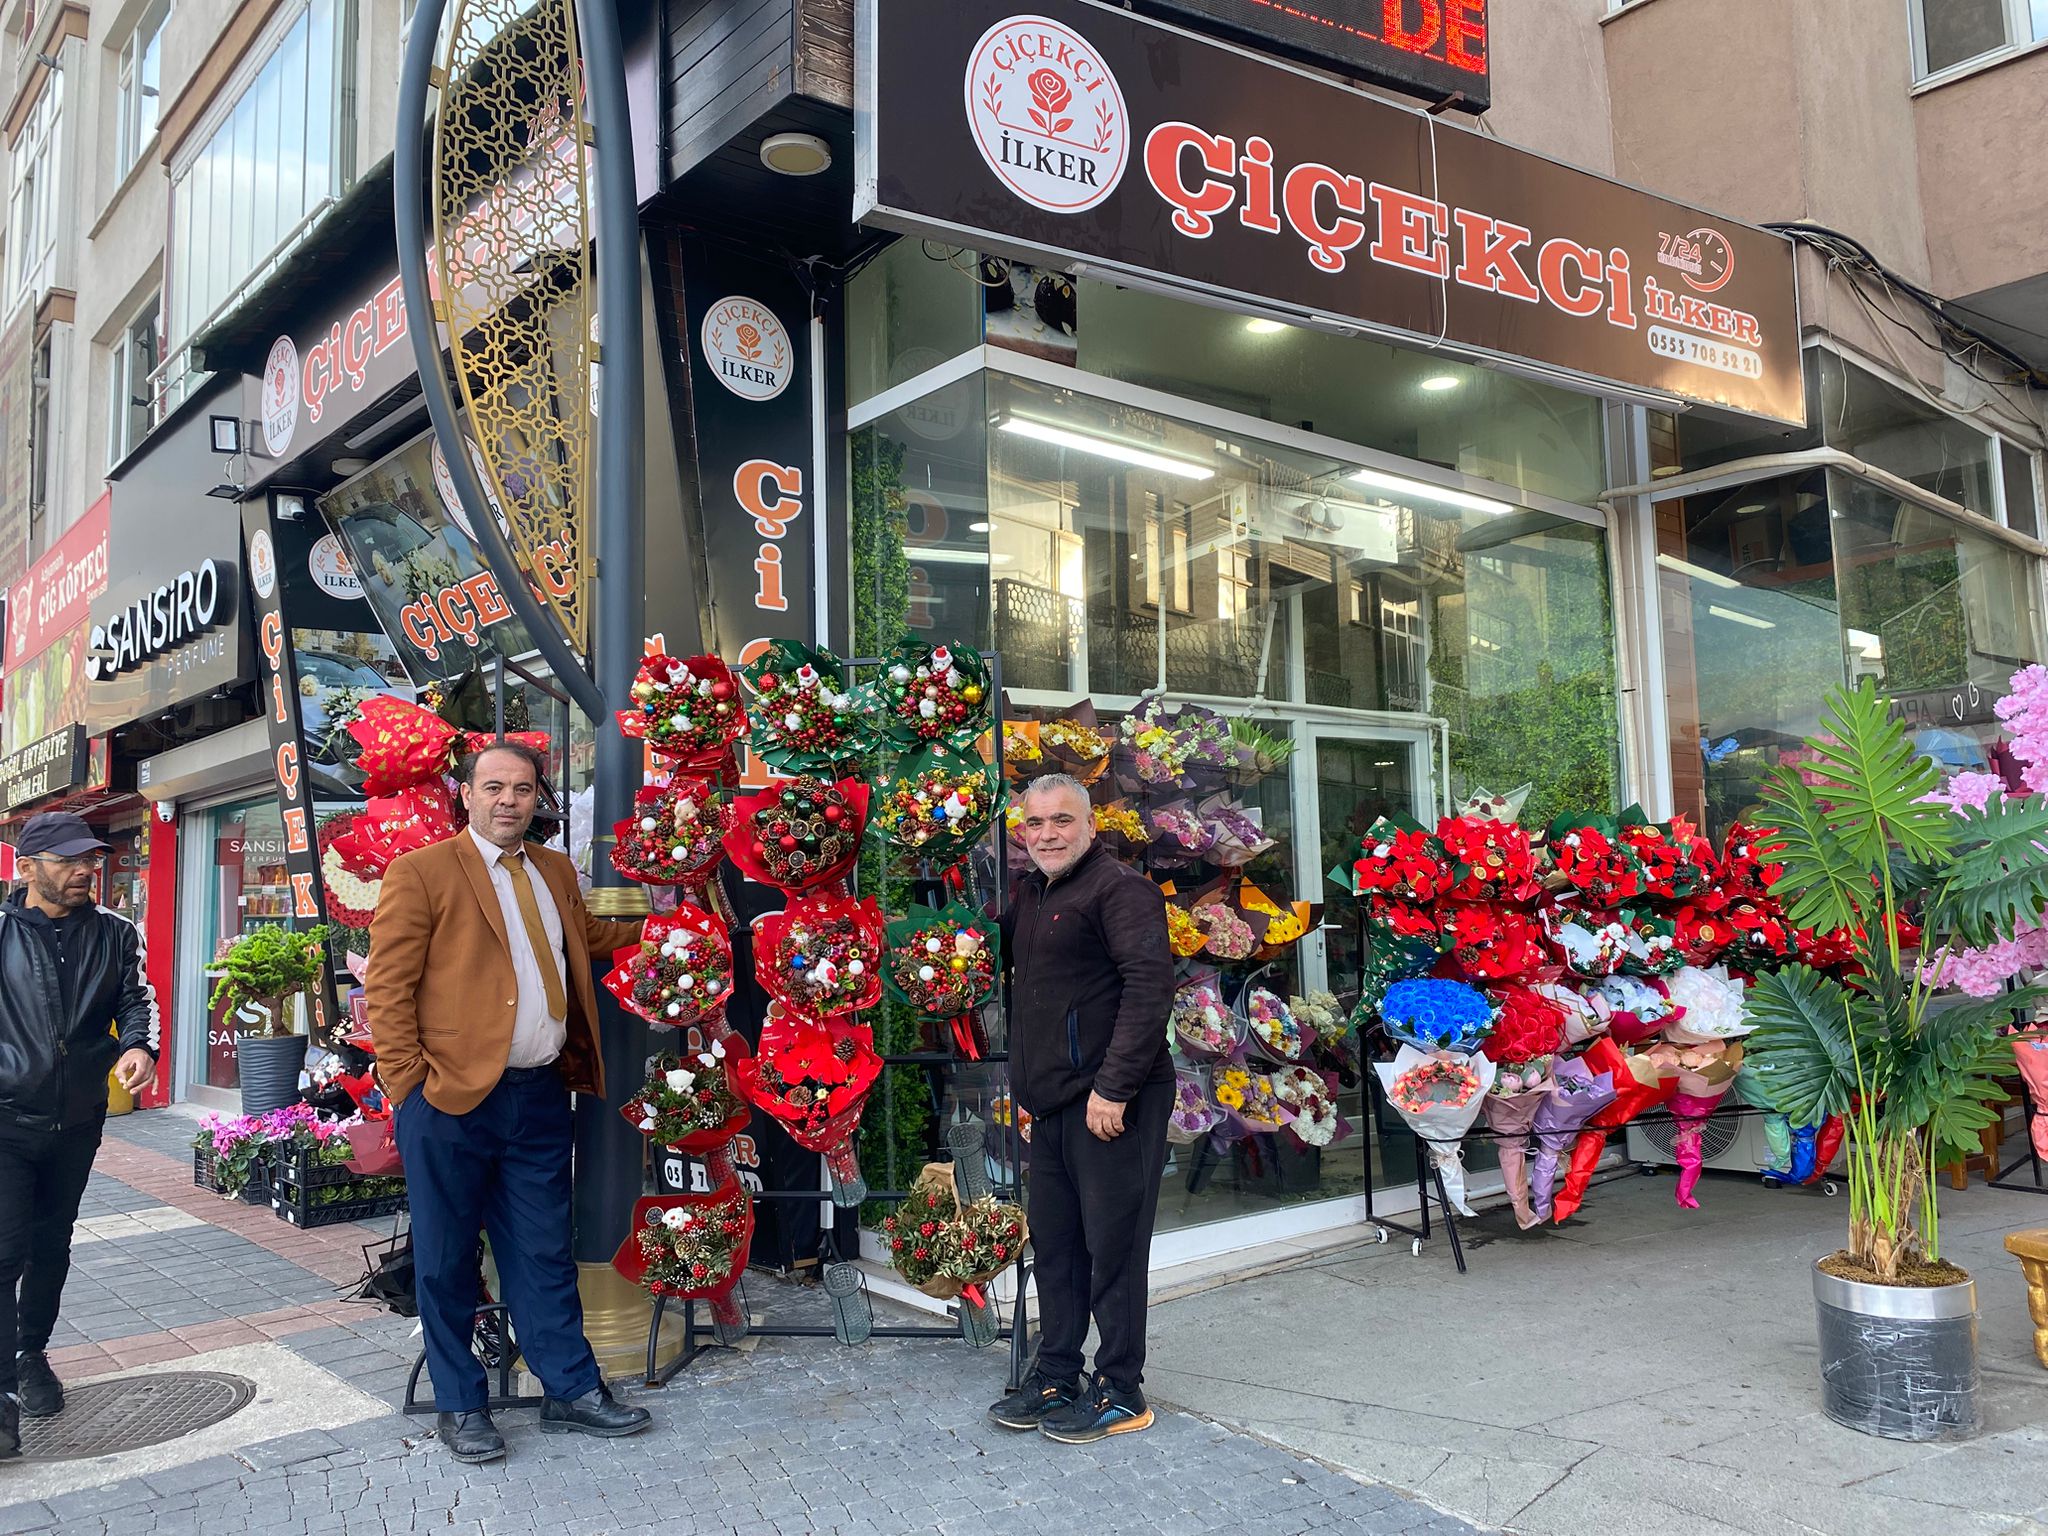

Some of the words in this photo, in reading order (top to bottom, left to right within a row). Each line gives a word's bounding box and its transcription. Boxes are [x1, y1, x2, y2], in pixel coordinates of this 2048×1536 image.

[992, 33, 1105, 93] ÇİÇEKÇİ
[1000, 130, 1099, 187] İLKER
[1658, 231, 1702, 263] 7/24
[716, 305, 780, 338] ÇİÇEKÇİ
[1651, 331, 1685, 355] 0553
[1691, 343, 1717, 363] 708
[721, 356, 777, 387] İLKER
[268, 409, 293, 442] İLKER
[57, 529, 108, 613] KÖFTECİ
[323, 573, 362, 589] İLKE
[167, 632, 226, 679] PERFUME
